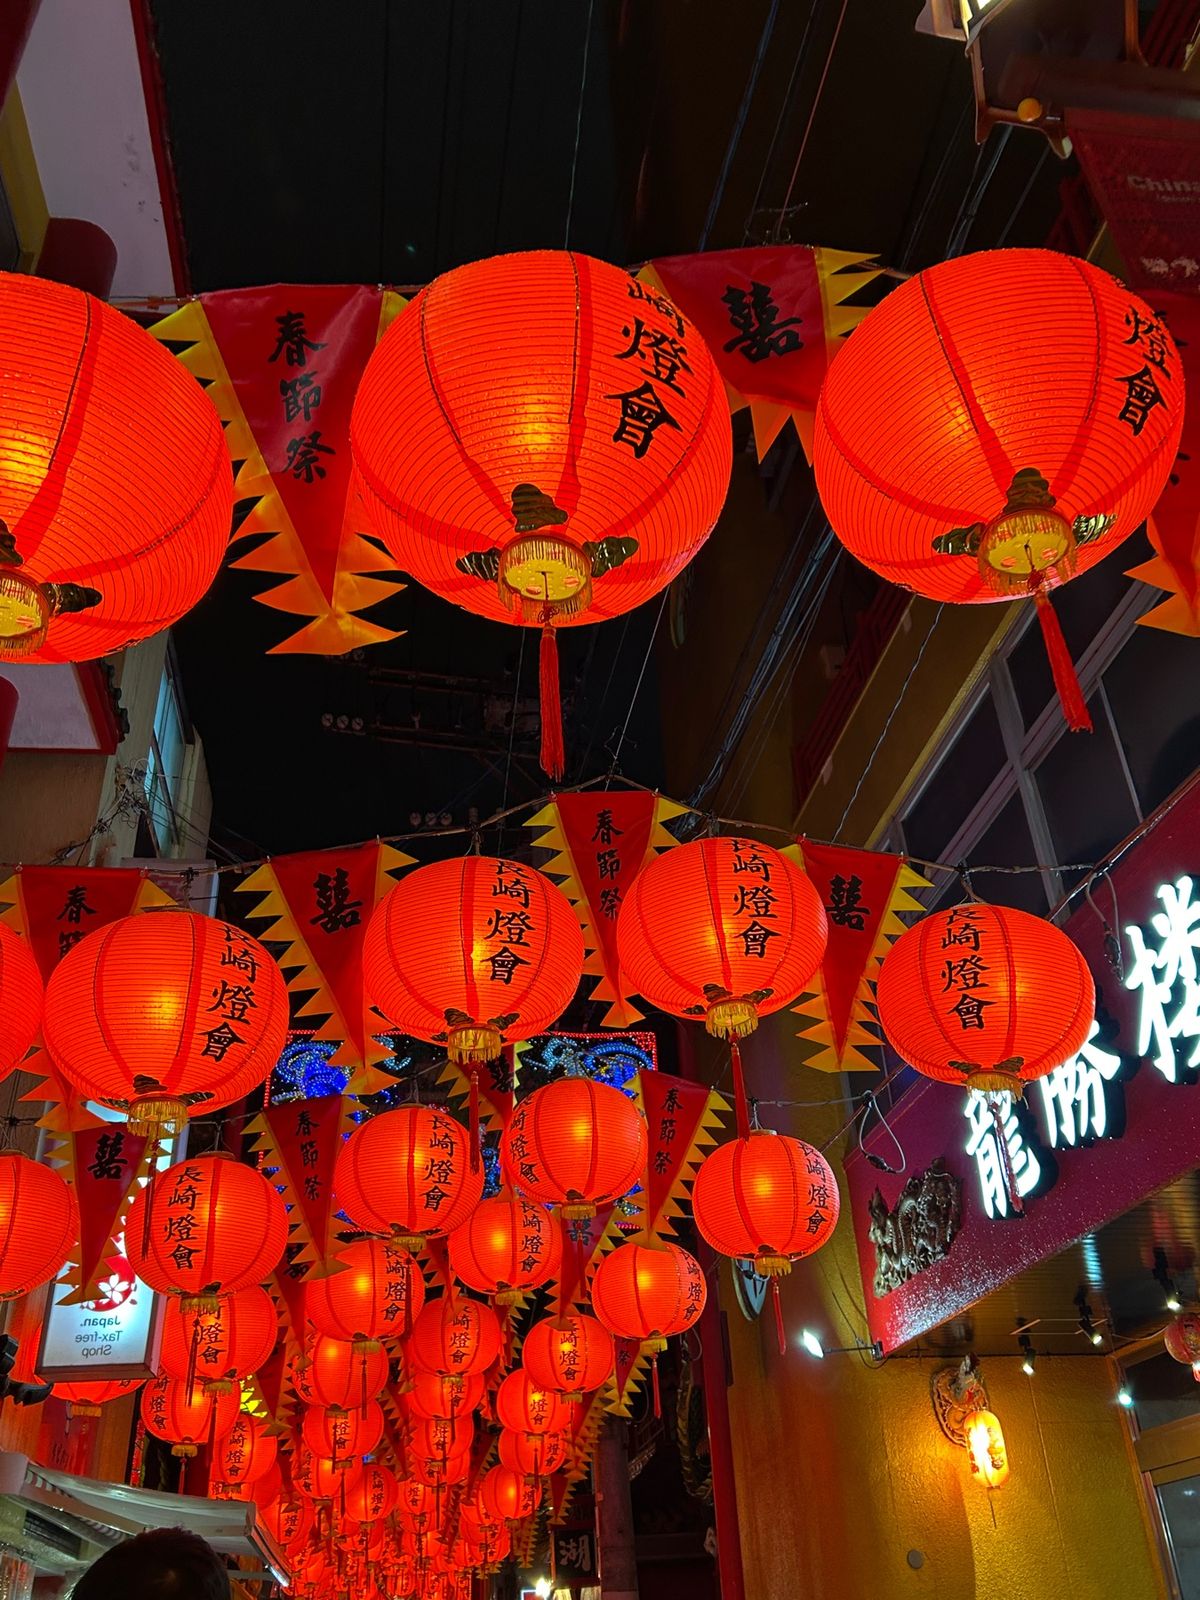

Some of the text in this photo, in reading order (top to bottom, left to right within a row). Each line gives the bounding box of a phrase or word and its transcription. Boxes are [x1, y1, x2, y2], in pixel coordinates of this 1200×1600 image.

[268, 310, 336, 483] 春節祭
[591, 808, 625, 921] 春節祭
[722, 838, 782, 959] 長崎燈會
[480, 861, 536, 985] 長崎燈會
[940, 908, 998, 1031] 長崎燈會
[197, 924, 263, 1062] 長崎燈會
[295, 1108, 324, 1201] 春節祭
[419, 1114, 457, 1212] 長崎燈會
[654, 1087, 683, 1175] 春節祭
[164, 1166, 203, 1270] 長崎燈會
[519, 1199, 545, 1273] 長崎燈會
[797, 1140, 832, 1235] 長崎燈會
